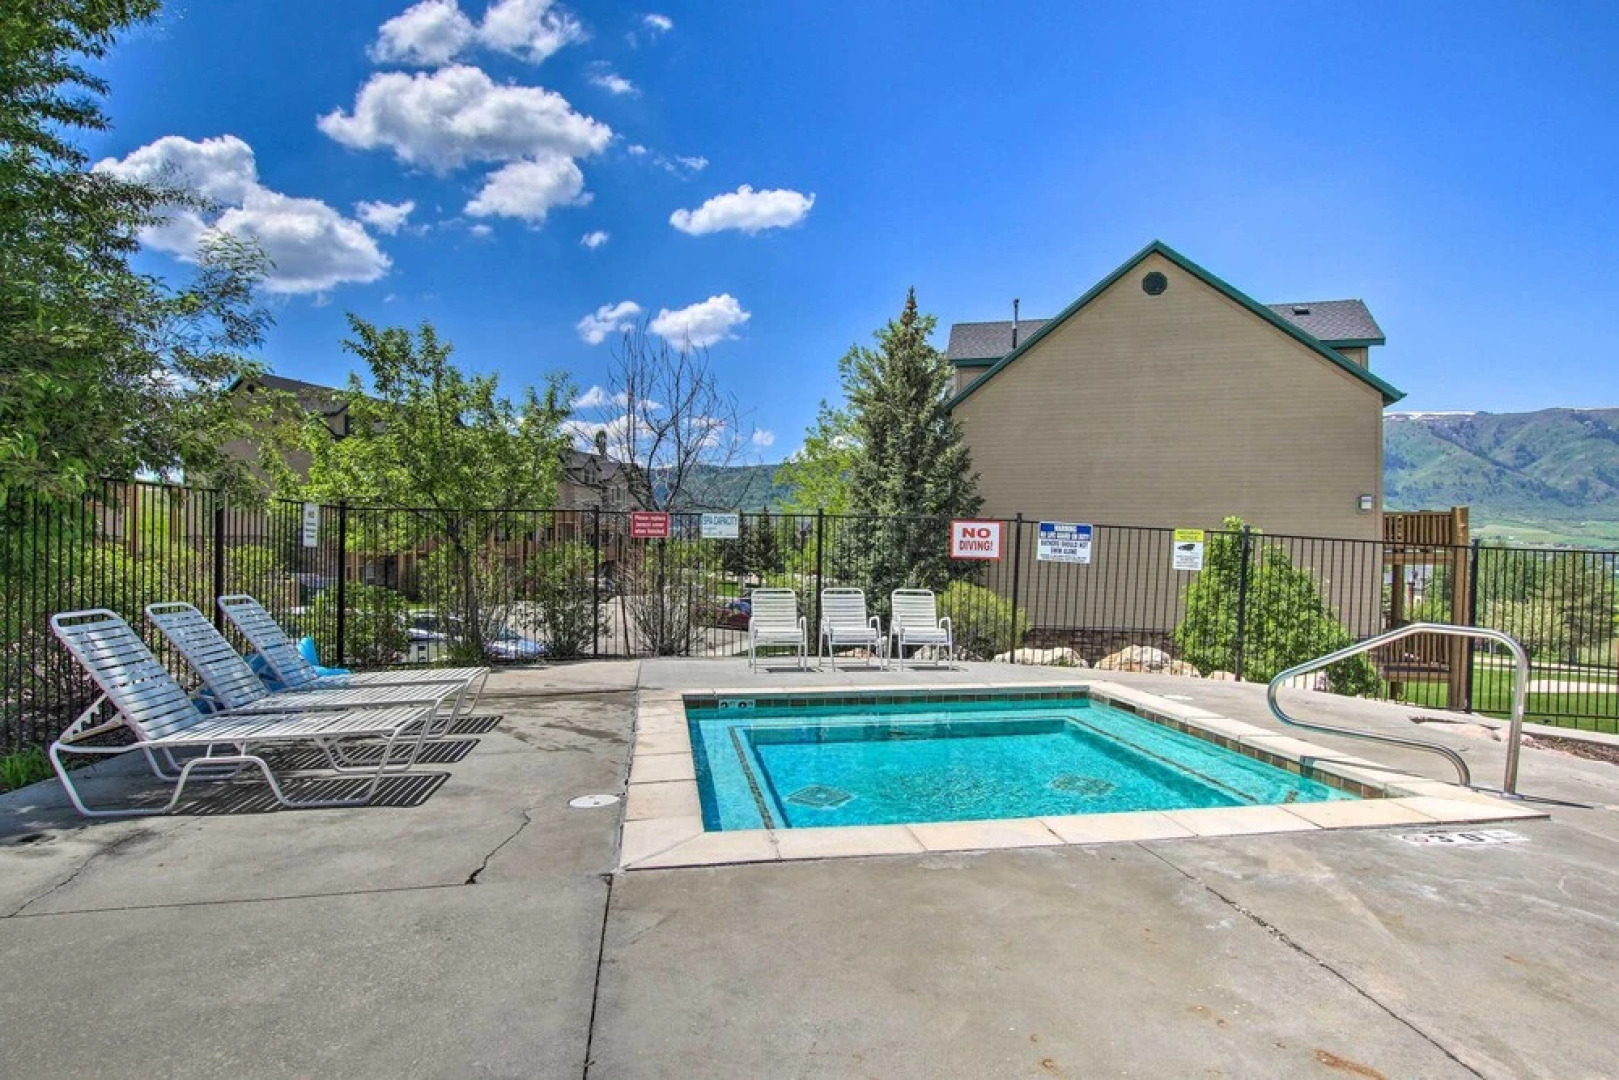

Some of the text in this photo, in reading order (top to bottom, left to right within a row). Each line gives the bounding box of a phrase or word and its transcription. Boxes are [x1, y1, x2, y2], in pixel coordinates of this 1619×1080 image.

[713, 515, 738, 525] CAPACITY
[962, 527, 991, 538] NO
[959, 540, 993, 551] DIVING!
